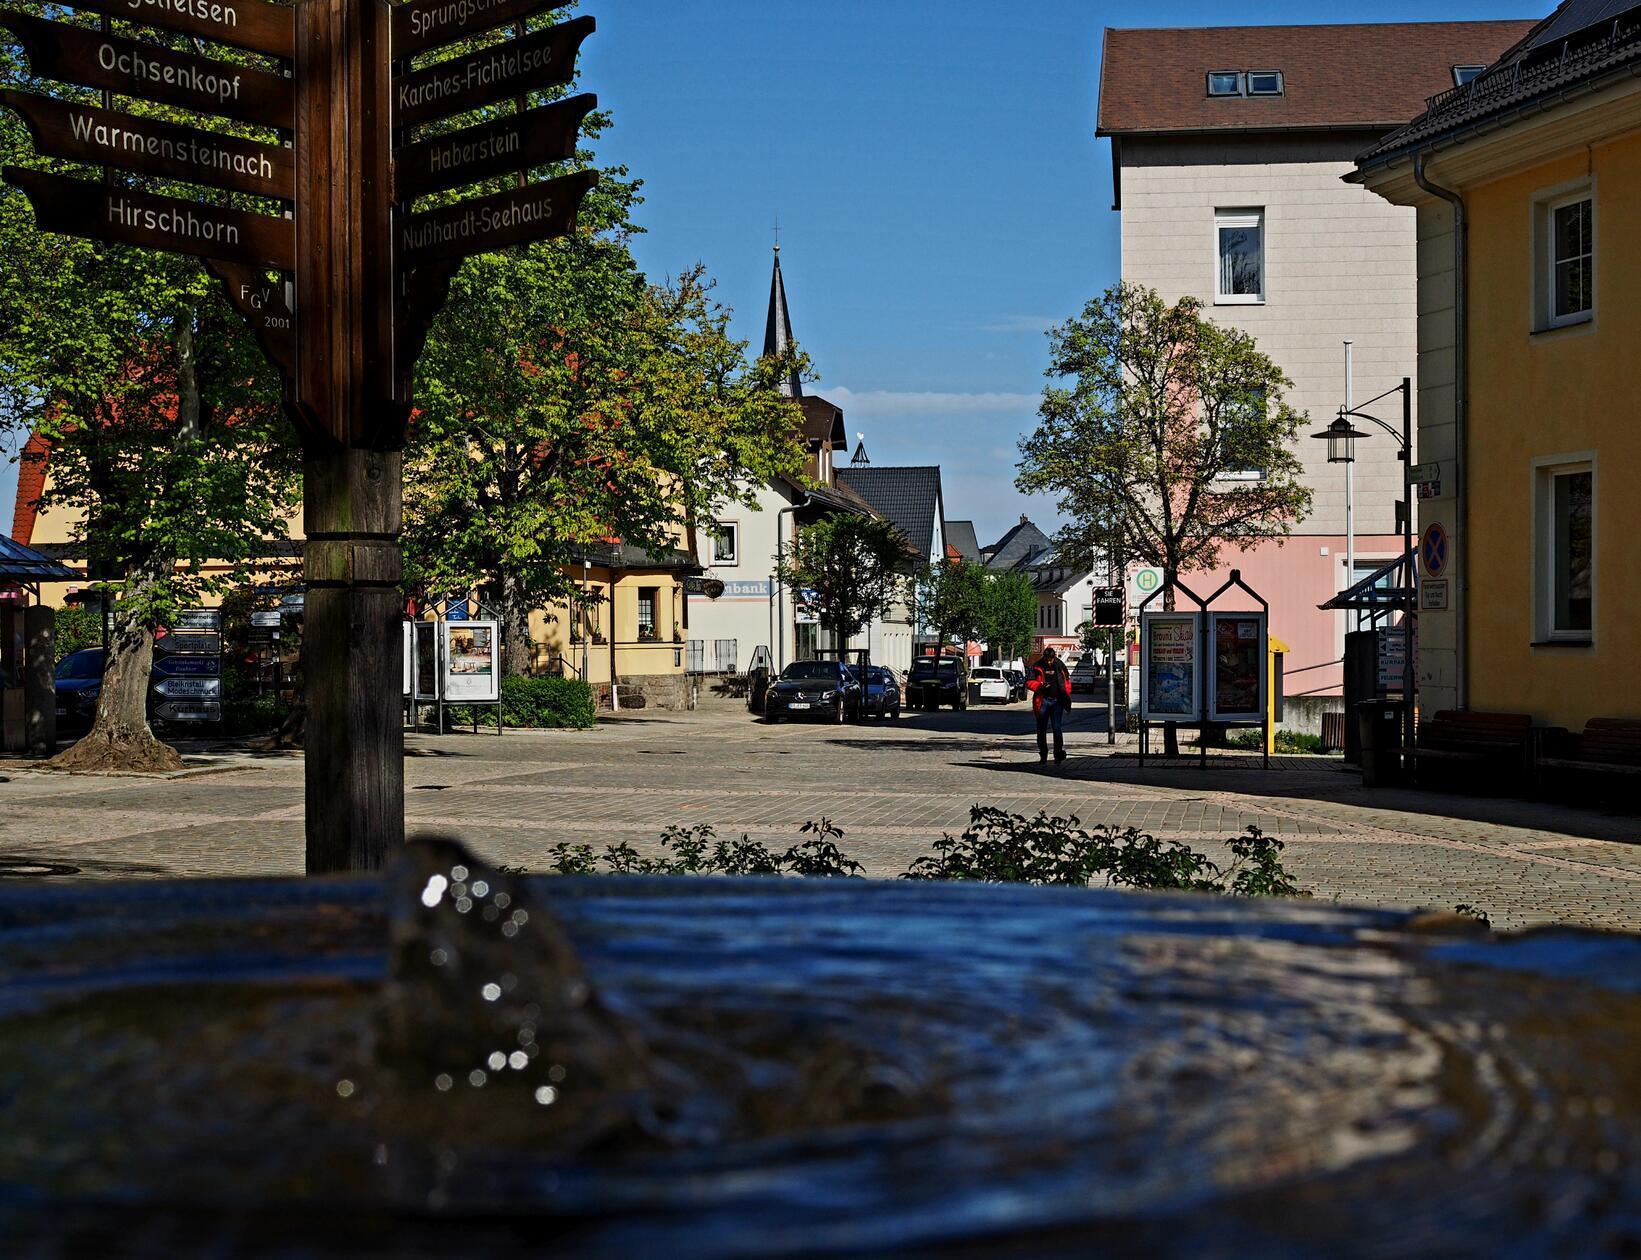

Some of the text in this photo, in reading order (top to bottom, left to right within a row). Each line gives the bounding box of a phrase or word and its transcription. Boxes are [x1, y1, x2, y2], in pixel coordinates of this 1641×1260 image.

[99, 43, 241, 104] Ochsenkopf
[399, 45, 552, 110] Karches-Fichtelsee
[69, 112, 273, 179] Warmensteinach
[429, 127, 520, 173] Haberstein
[108, 196, 239, 245] Hirschhorn
[401, 198, 553, 251] Nußhardt-Seehaus
[264, 315, 290, 329] 2001
[167, 680, 204, 688] Bleikristall
[167, 687, 217, 695] Modeschmuck
[169, 704, 216, 713] Kurhaus
